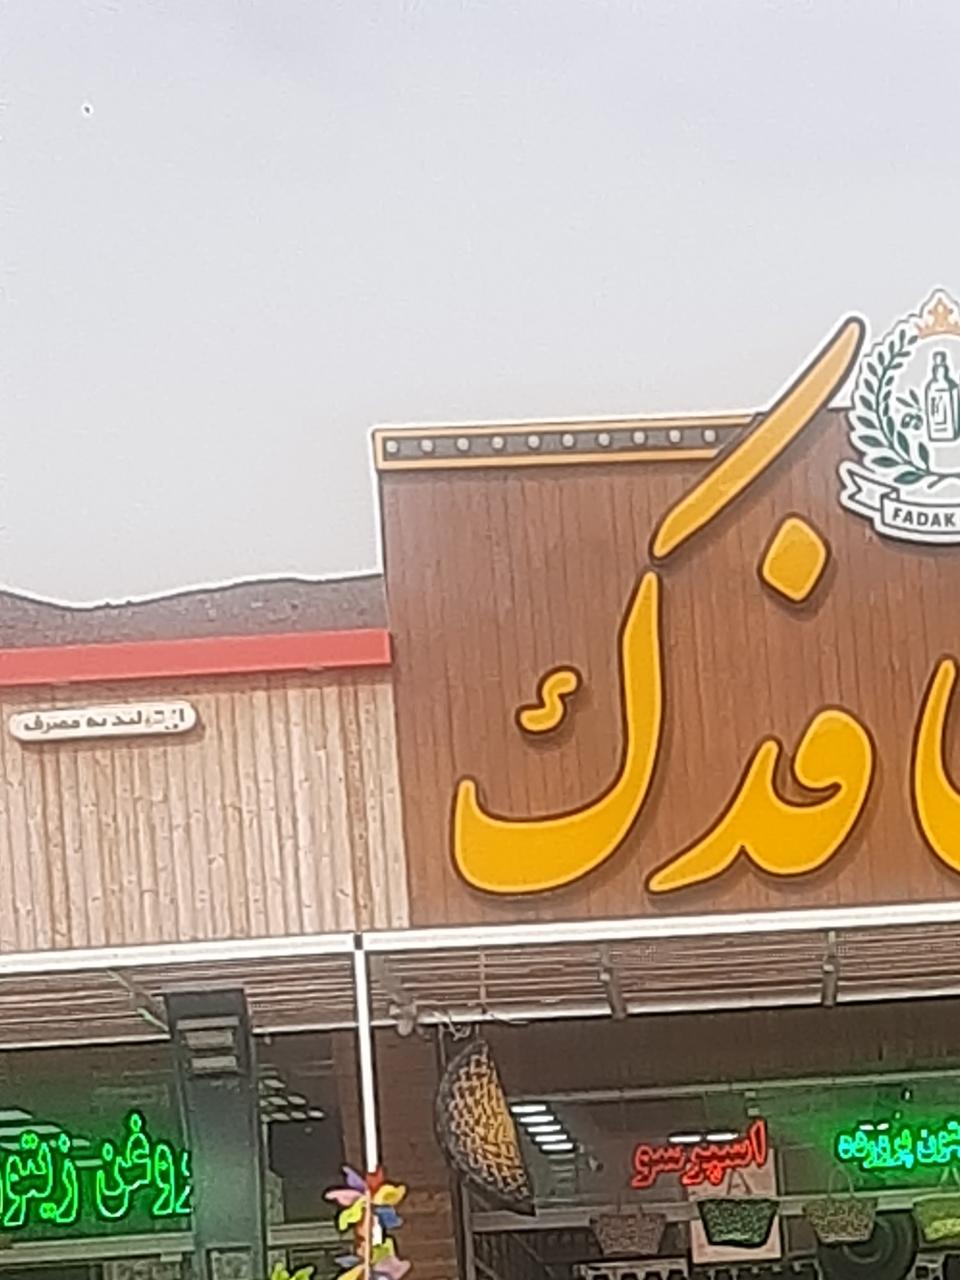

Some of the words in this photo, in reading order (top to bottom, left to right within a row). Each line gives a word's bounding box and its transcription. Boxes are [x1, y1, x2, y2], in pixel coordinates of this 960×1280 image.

[892, 507, 956, 527] FADAK
[453, 316, 876, 895] فدک
[23, 714, 81, 735] مصرف
[0, 1132, 78, 1227] زیتو
[631, 1119, 767, 1187] اسپرسو
